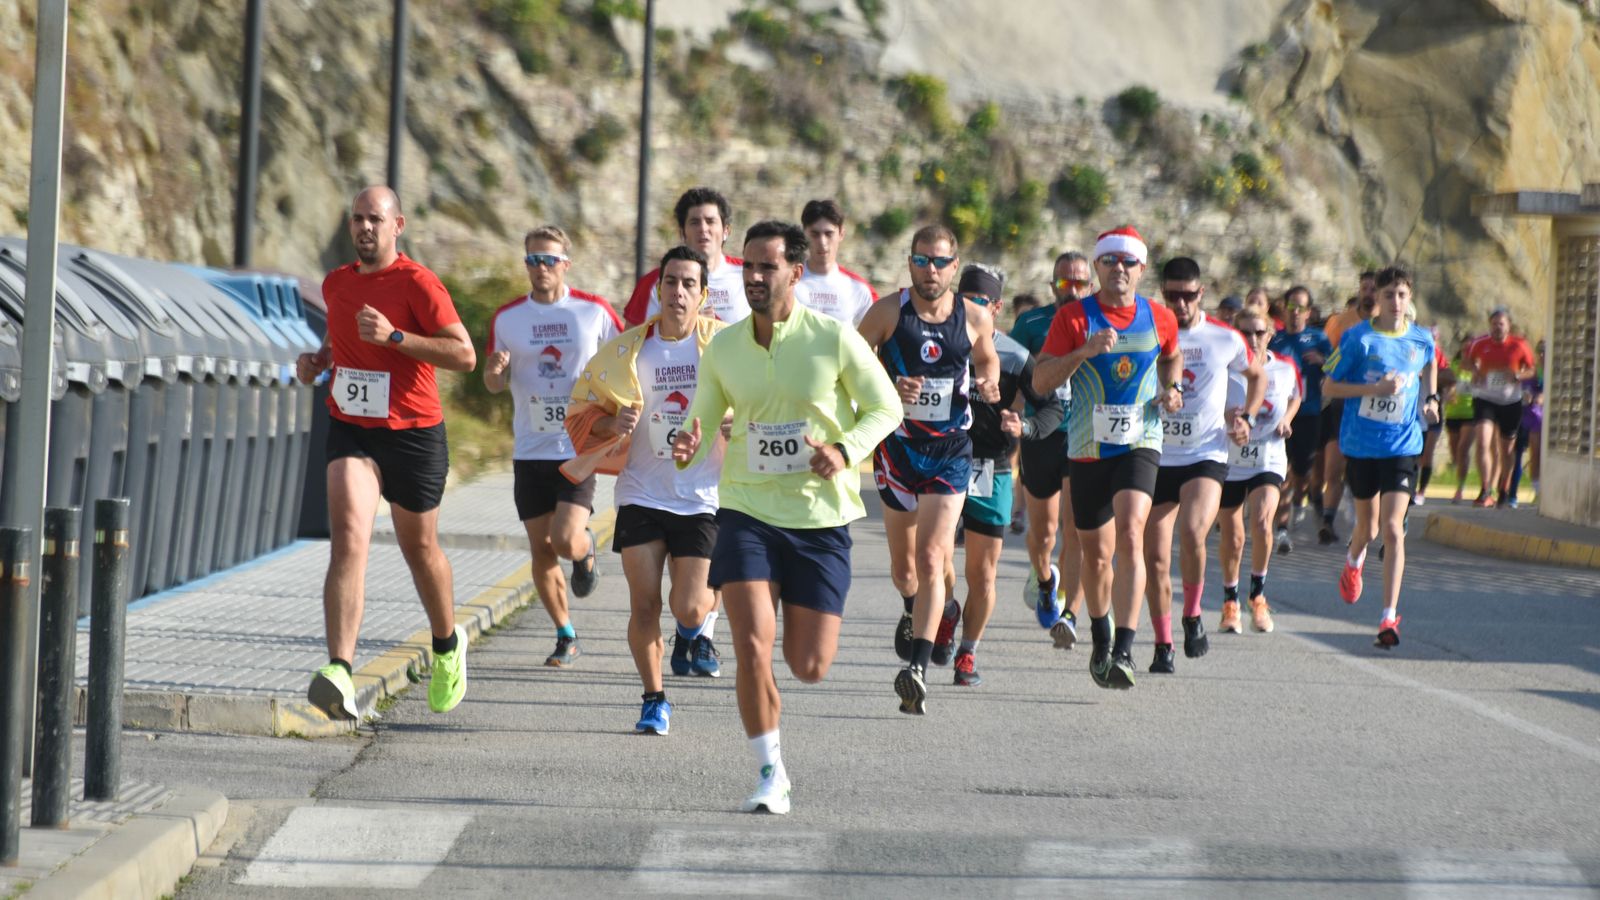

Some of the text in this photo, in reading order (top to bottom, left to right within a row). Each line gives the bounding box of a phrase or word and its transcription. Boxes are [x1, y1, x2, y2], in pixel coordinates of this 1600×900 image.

[538, 322, 568, 332] CARRERA
[655, 364, 696, 376] II CARRERA
[655, 373, 696, 384] SAN SILVESTRE
[347, 383, 369, 403] 91
[913, 393, 942, 406] 59
[1368, 397, 1397, 414] 190
[544, 406, 566, 422] 38
[1109, 417, 1131, 433] 75
[1162, 421, 1192, 437] 238
[758, 438, 799, 457] 260
[1240, 446, 1259, 459] 84
